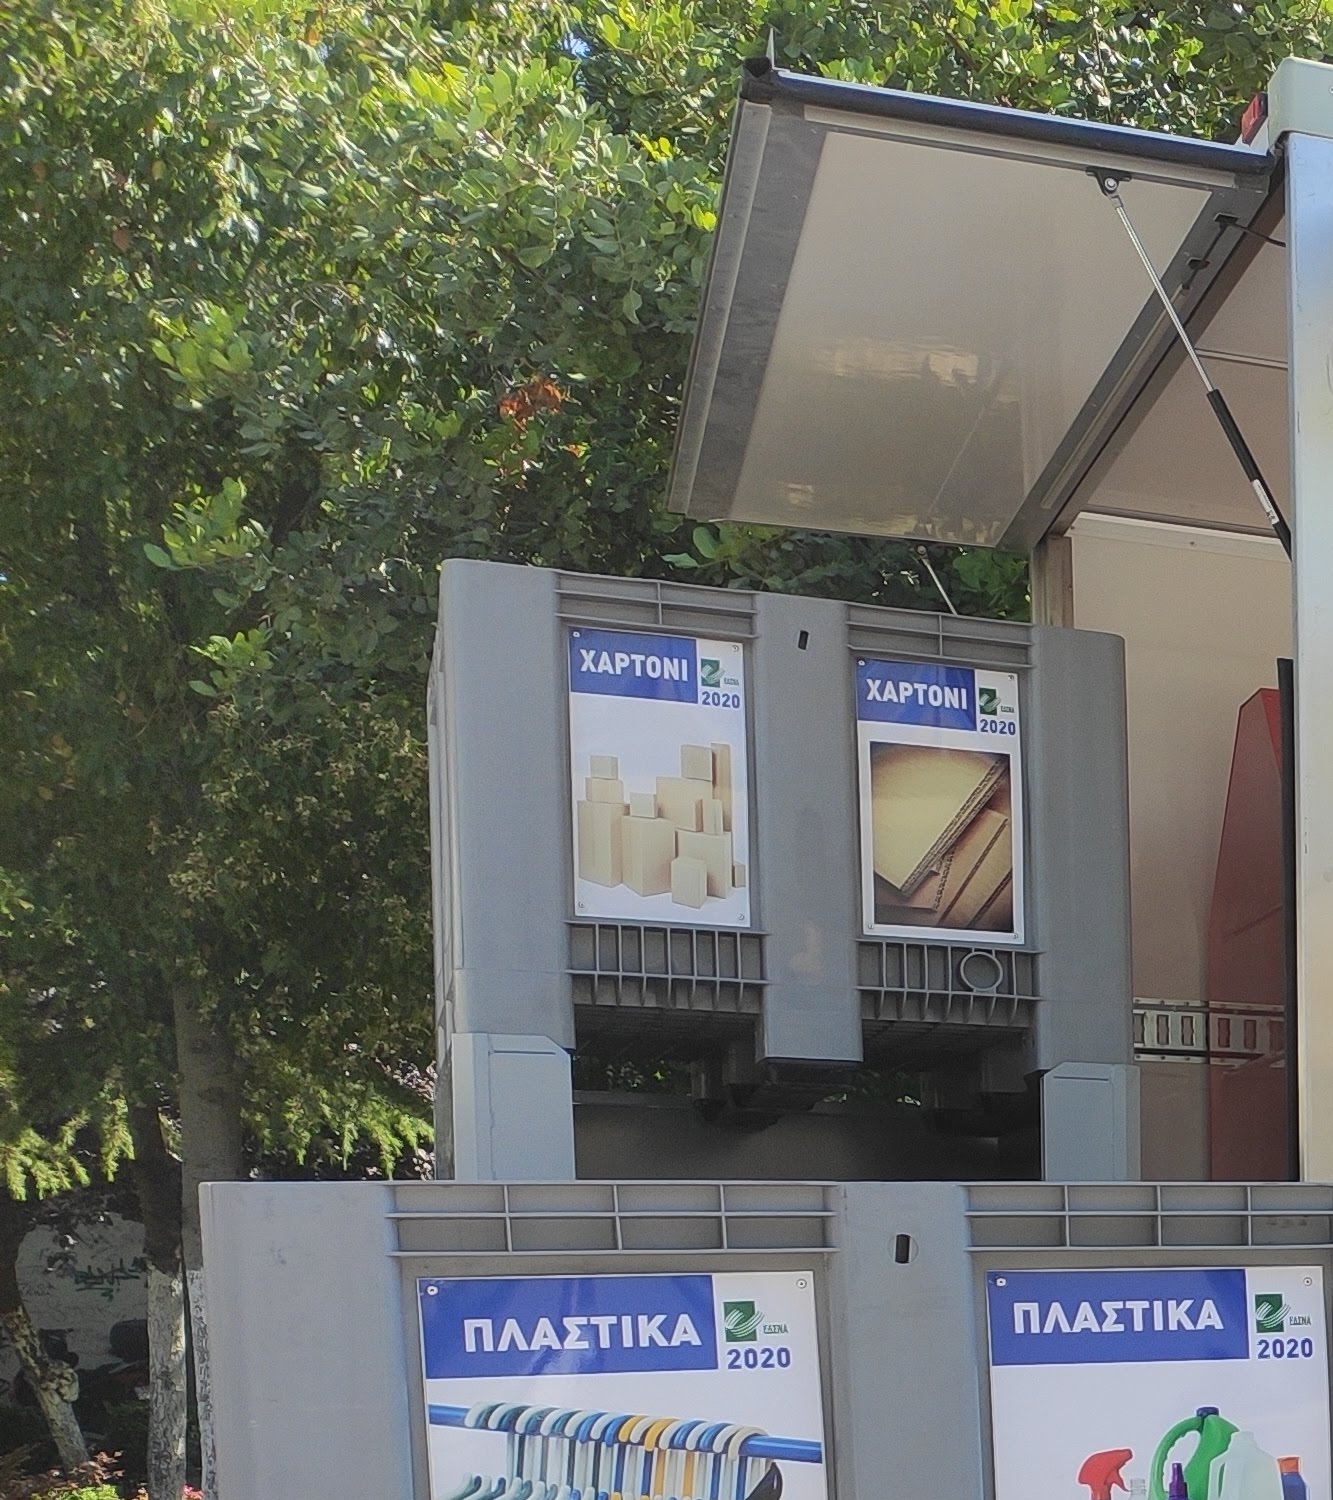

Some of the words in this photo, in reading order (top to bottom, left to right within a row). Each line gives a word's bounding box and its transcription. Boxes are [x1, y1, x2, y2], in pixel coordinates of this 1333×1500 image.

[579, 648, 689, 682] ΧΑΡΤΟΝΙ
[701, 690, 741, 709] 2020
[866, 678, 968, 710] ΧΑΡΤΟΝΙ
[979, 718, 1016, 736] 2020
[1013, 1300, 1224, 1334] ΠΛΑΣΤΙΚΑ
[463, 1313, 703, 1353] ΠΛΑΣΤΙΚΑ
[727, 1347, 791, 1370] 2020
[1257, 1338, 1313, 1359] 2020
